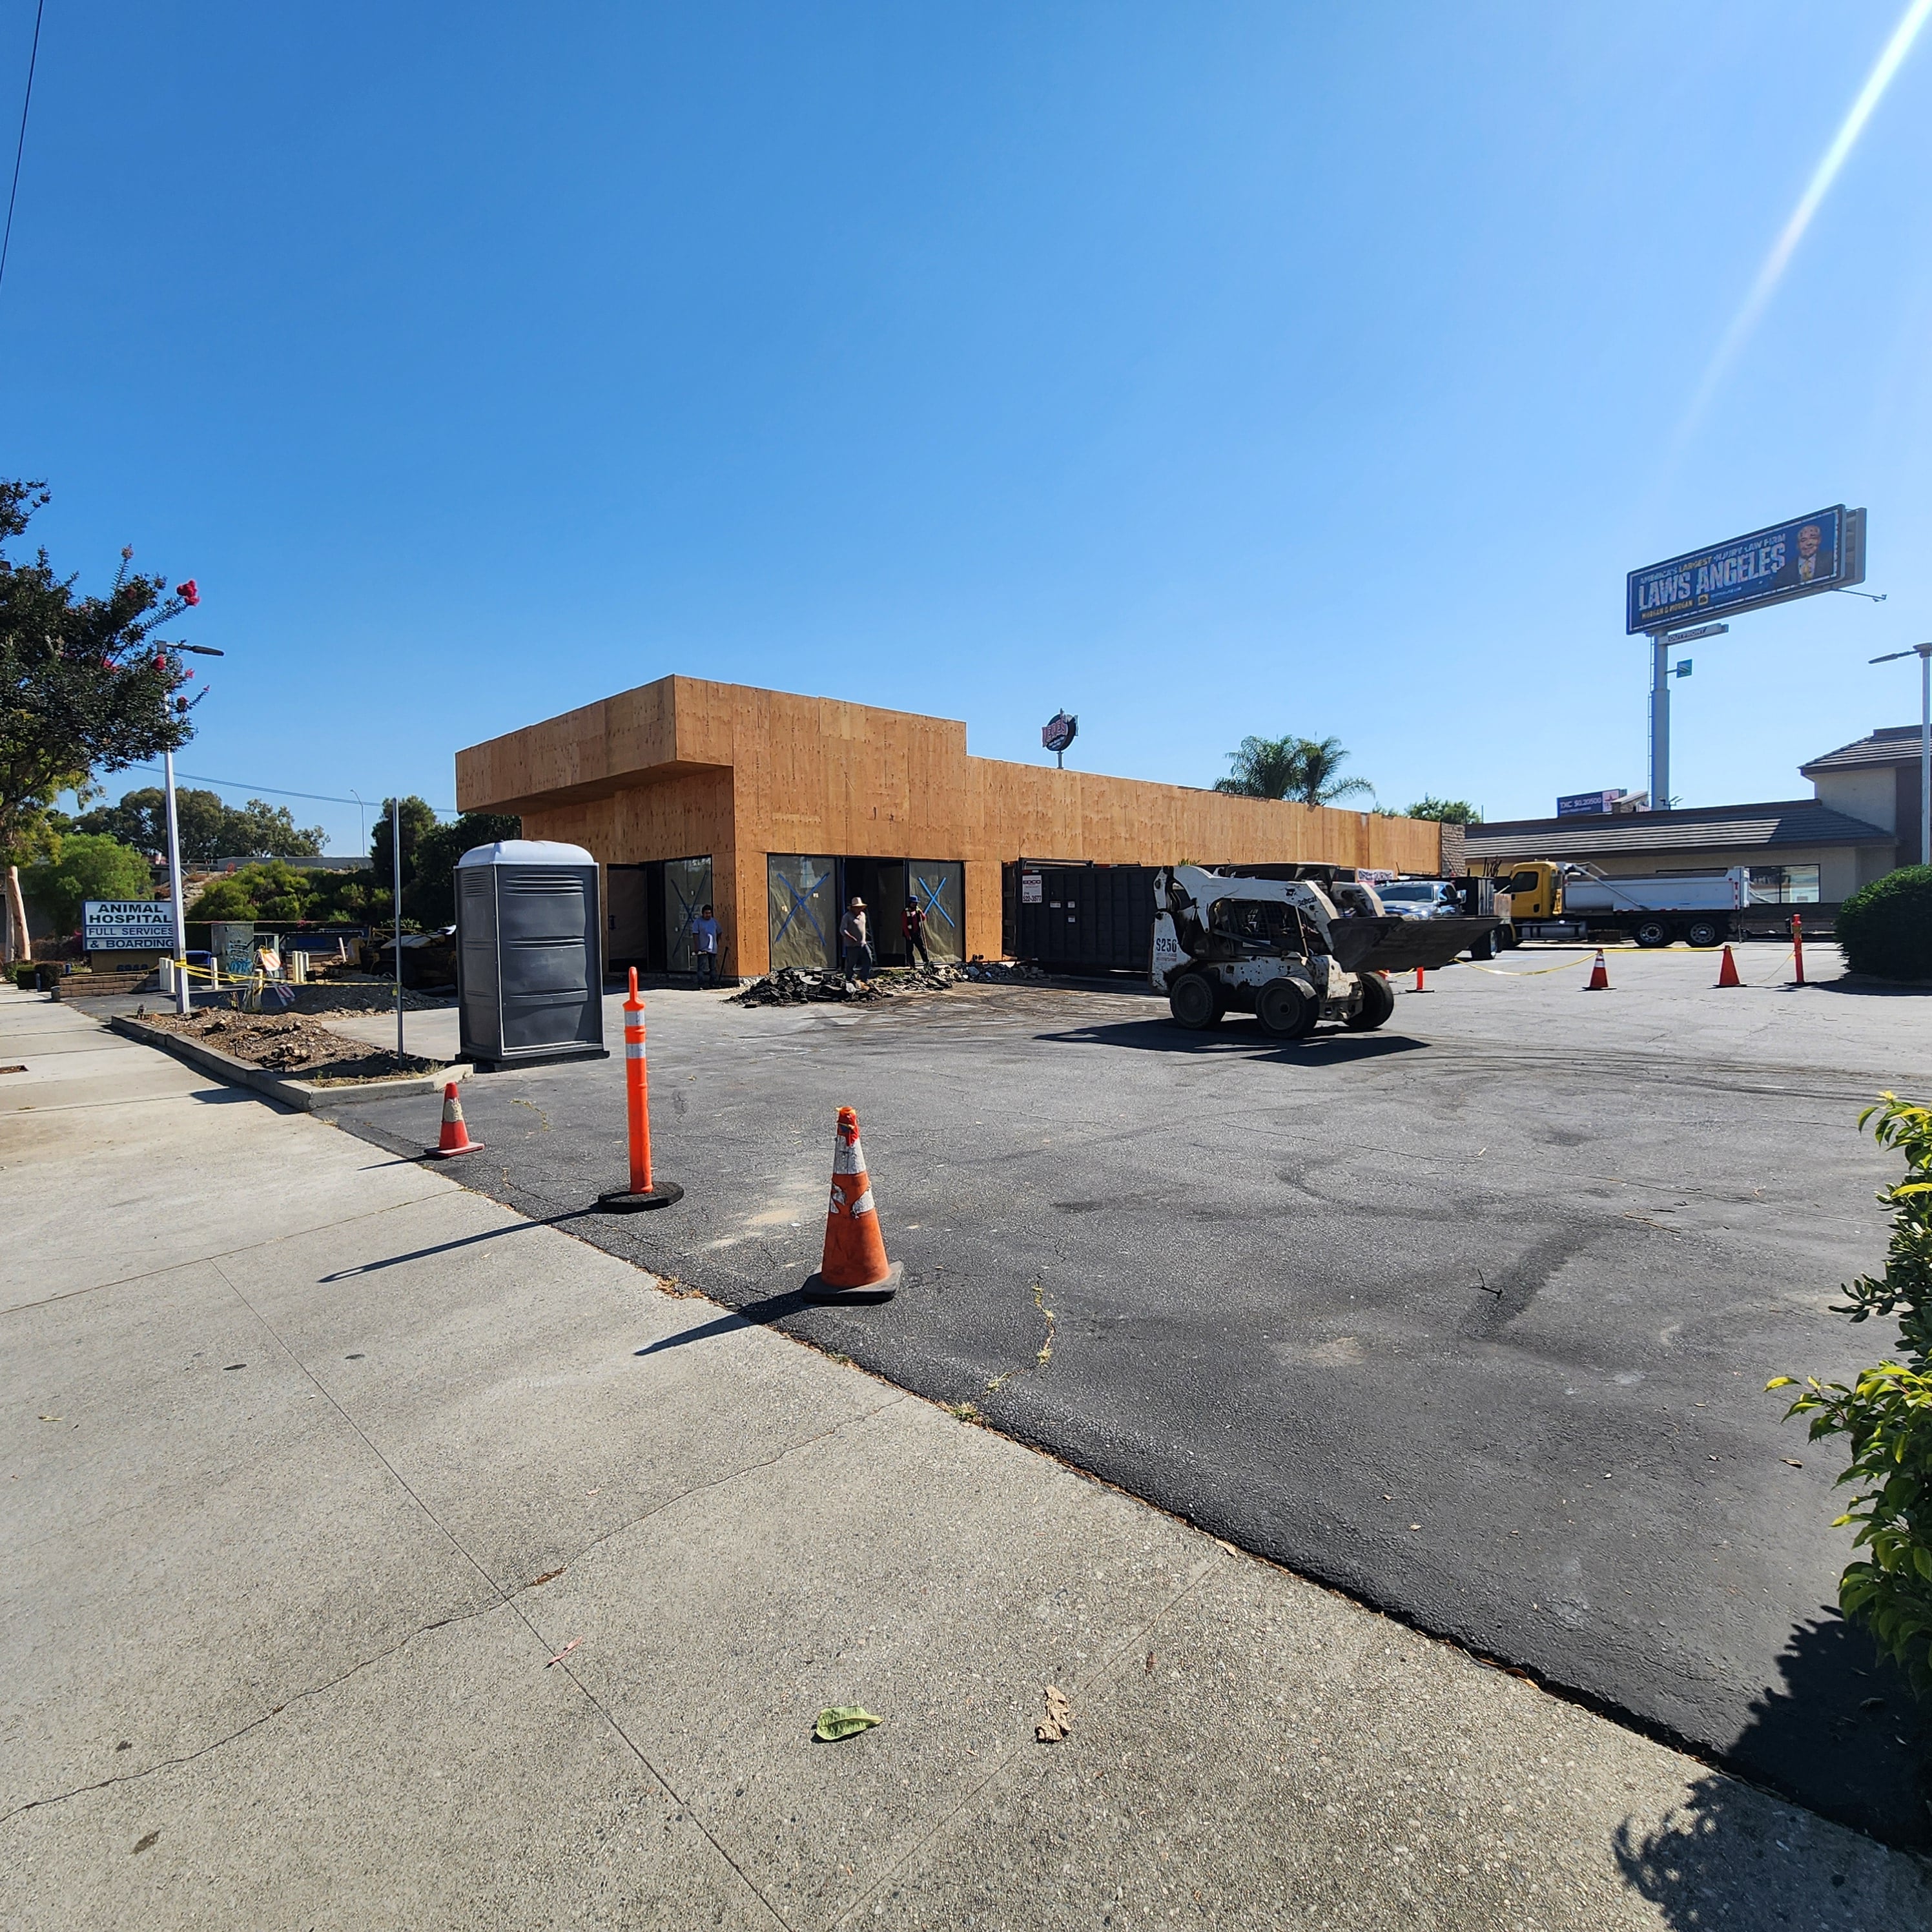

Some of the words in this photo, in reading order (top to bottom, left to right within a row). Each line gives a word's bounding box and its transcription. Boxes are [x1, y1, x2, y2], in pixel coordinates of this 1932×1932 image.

[1764, 533, 1786, 548] FIRM
[1638, 571, 1690, 611] LAWS
[1696, 542, 1786, 595] ANGELES
[98, 904, 163, 913] ANIMAL
[89, 915, 172, 923] HOSPITAL
[106, 939, 174, 948] BOARDING
